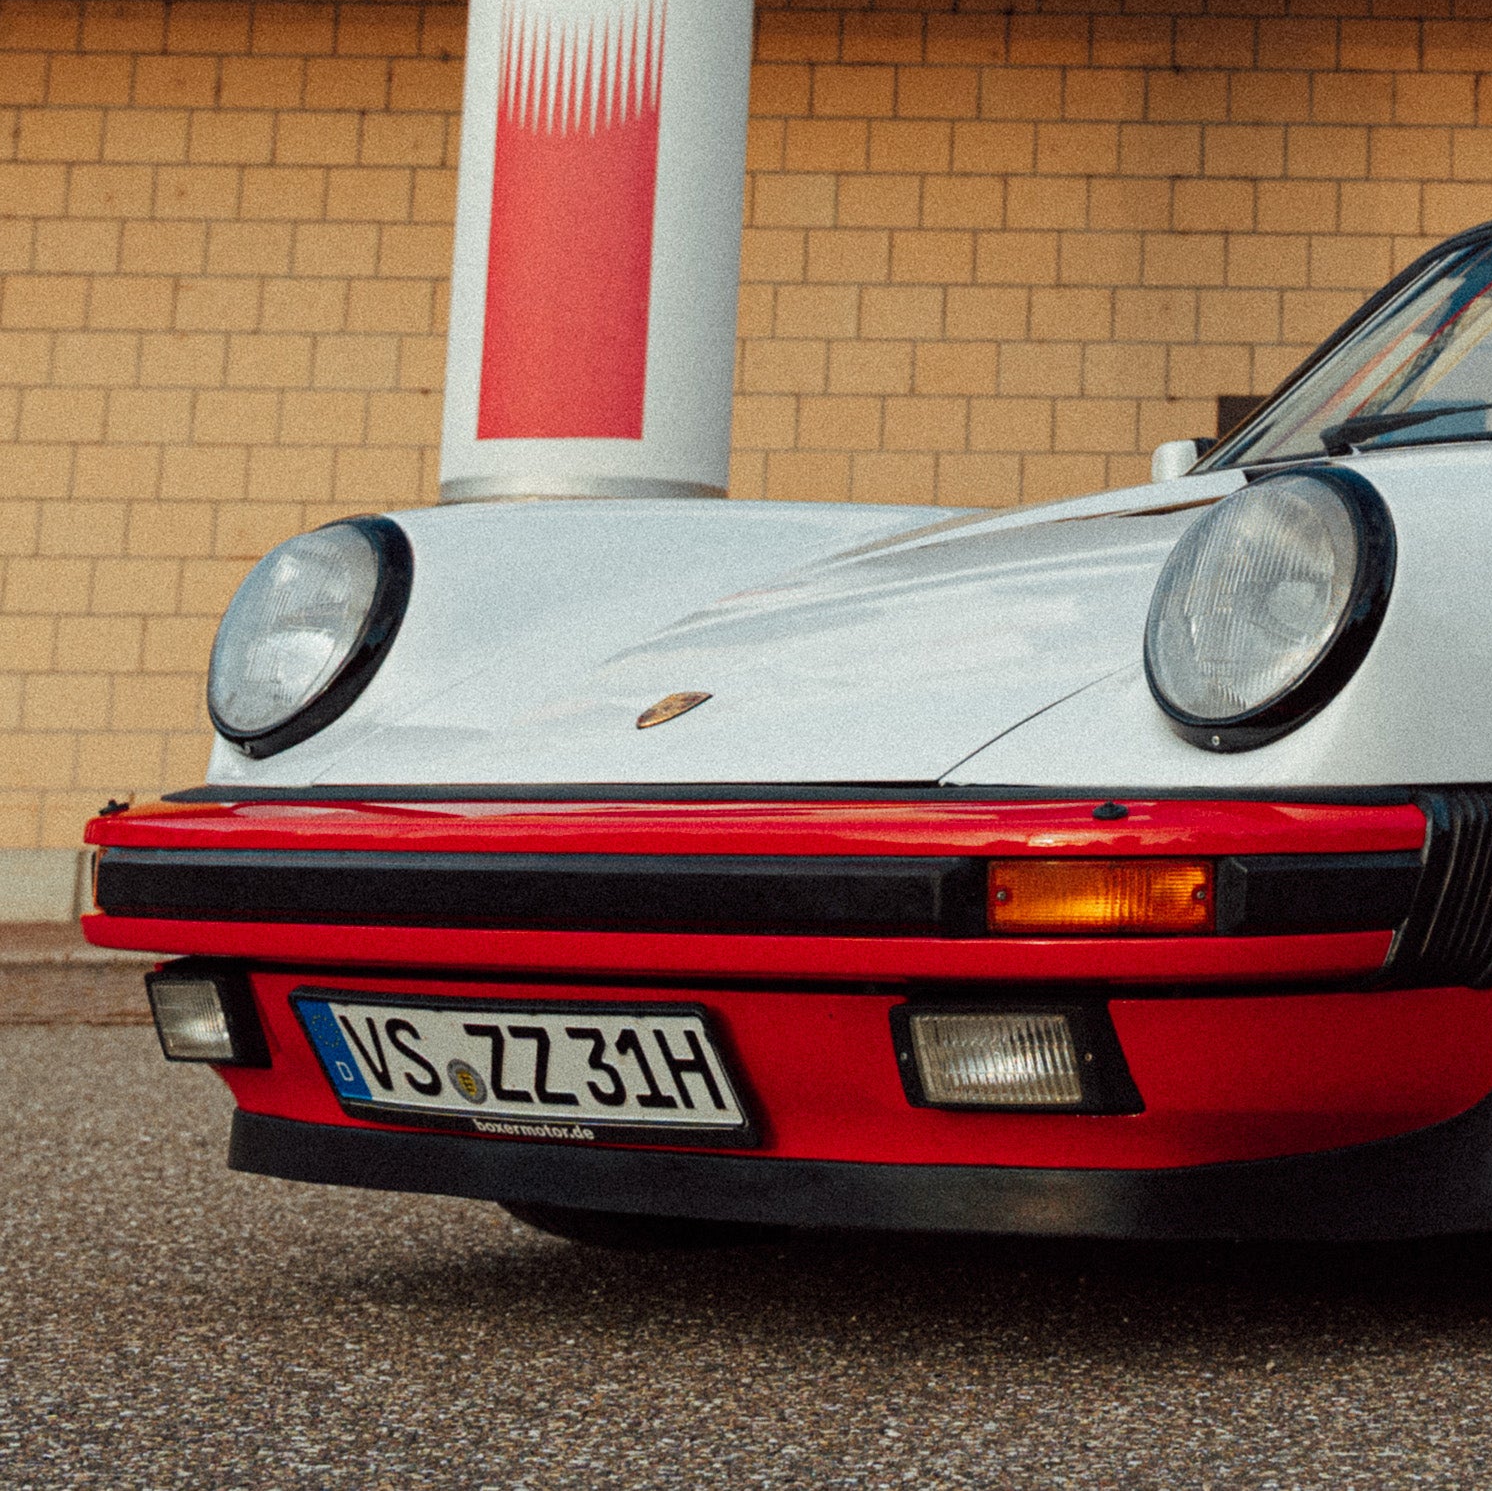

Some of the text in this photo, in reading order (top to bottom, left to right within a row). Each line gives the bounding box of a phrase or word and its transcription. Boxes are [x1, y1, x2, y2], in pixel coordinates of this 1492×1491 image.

[335, 1060, 354, 1081] D
[339, 1015, 727, 1110] VS ZZ 31H
[472, 1119, 595, 1140] boxermotor.de
